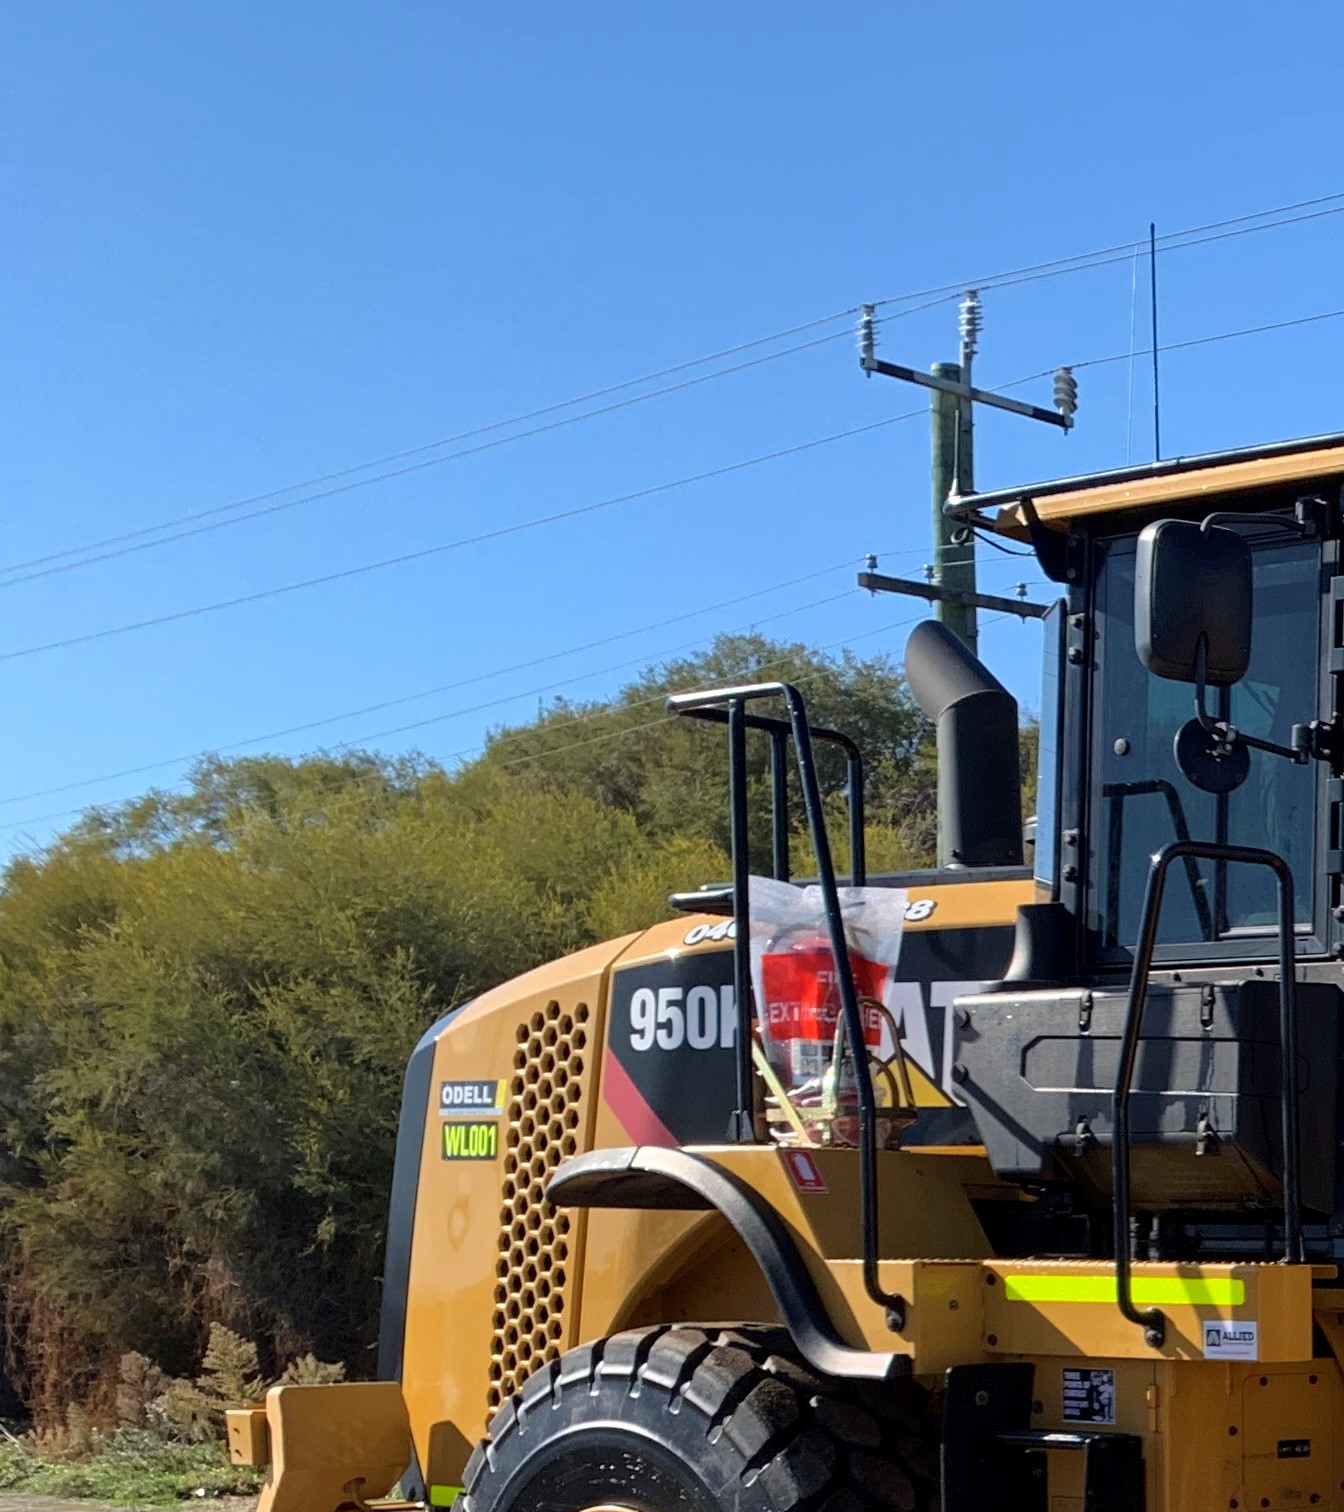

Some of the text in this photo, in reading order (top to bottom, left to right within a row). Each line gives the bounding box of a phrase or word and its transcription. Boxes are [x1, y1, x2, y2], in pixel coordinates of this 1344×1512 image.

[442, 1086, 492, 1104] ODELL
[445, 1125, 496, 1156] WL001
[1222, 1331, 1255, 1342] ALLIED
